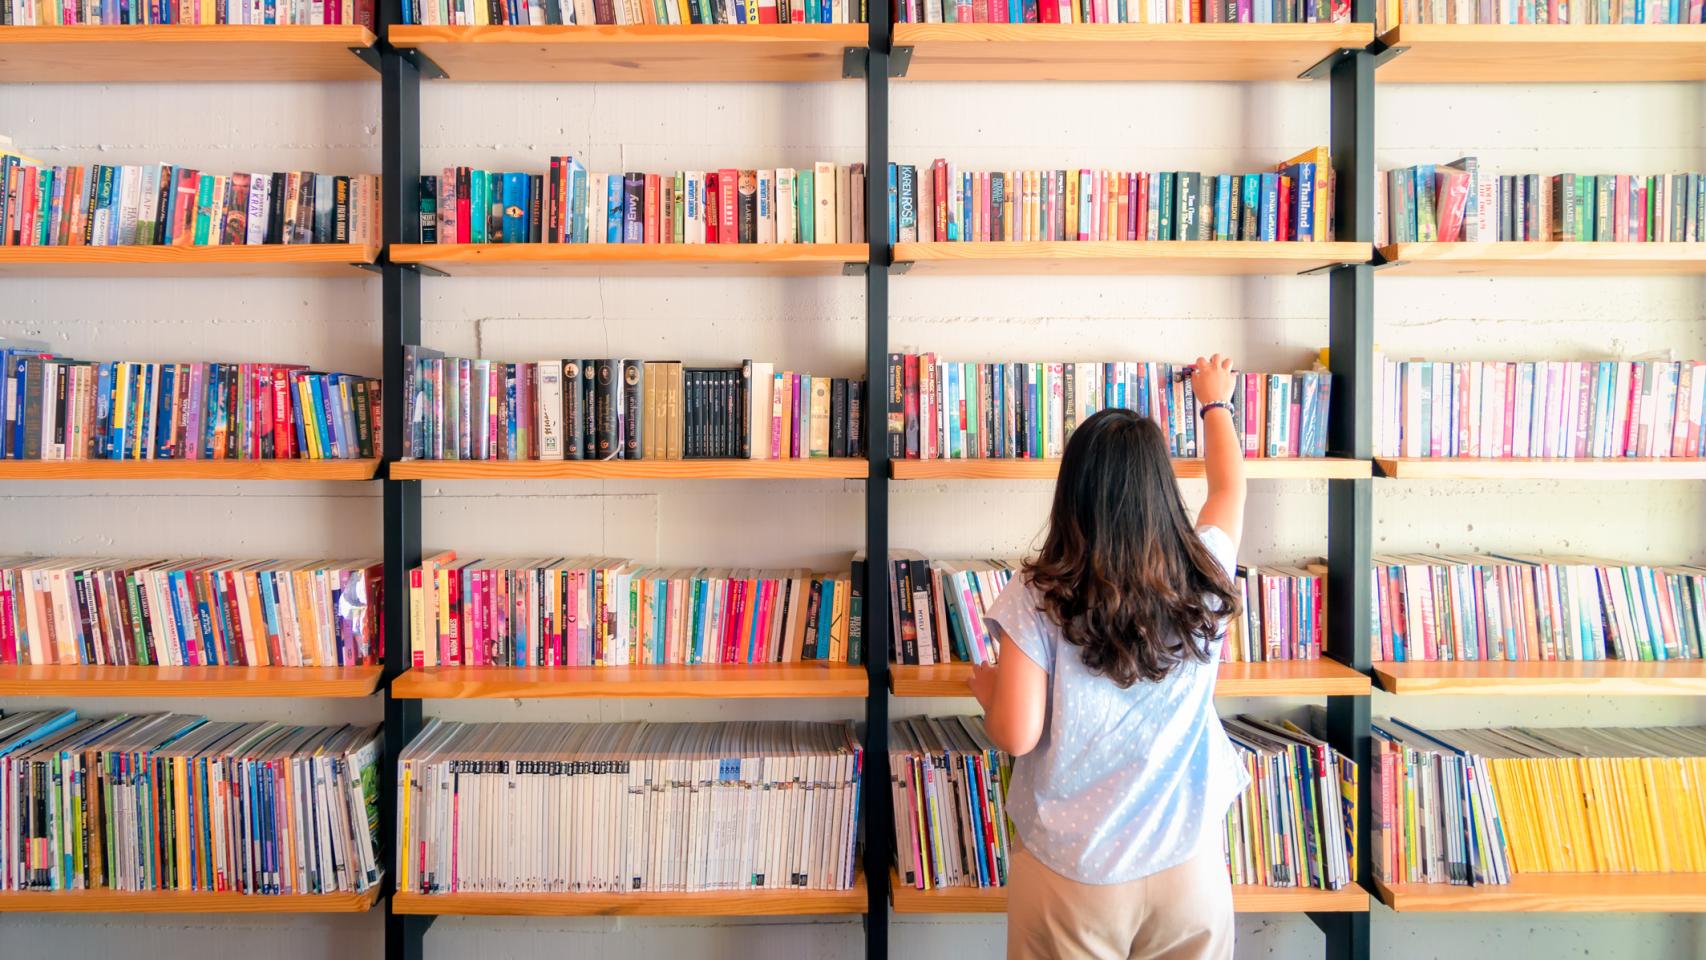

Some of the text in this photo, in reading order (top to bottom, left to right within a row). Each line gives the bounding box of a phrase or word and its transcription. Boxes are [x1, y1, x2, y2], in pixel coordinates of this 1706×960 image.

[250, 193, 258, 217] KRAY
[627, 194, 638, 221] Envy
[901, 166, 913, 224] KAREN ROSE
[1300, 181, 1311, 228] Thailand
[128, 582, 137, 615] STARBUCKED
[169, 618, 178, 647] ADVANTAGE
[449, 618, 458, 656] WARM BODIES
